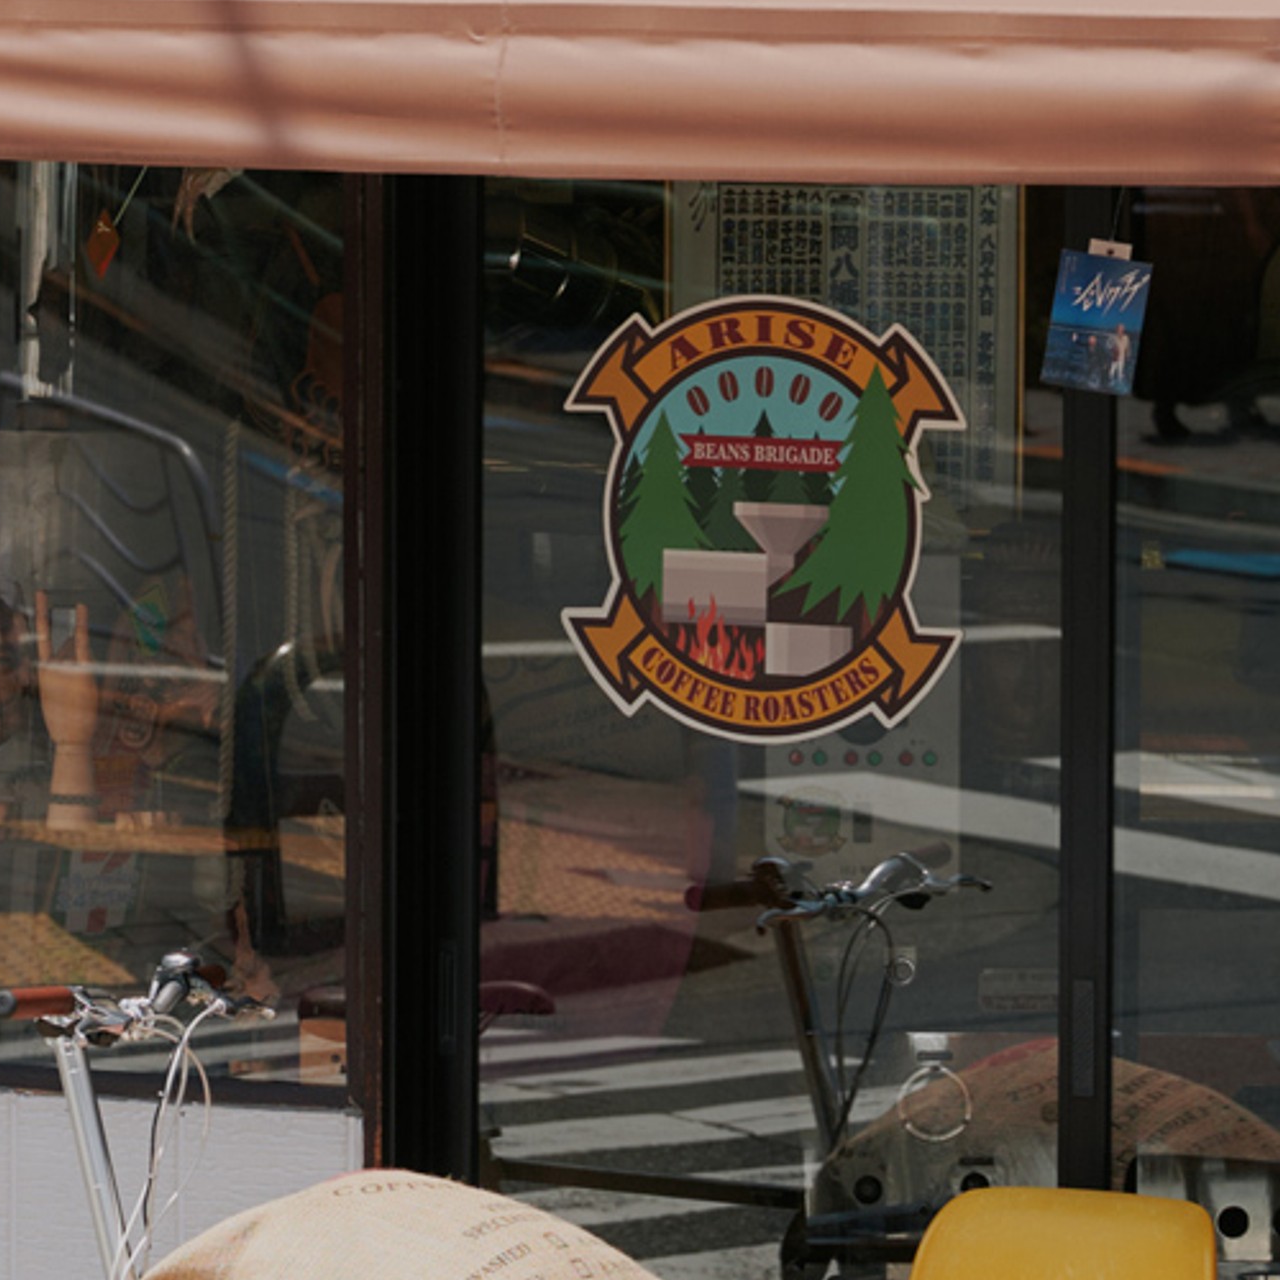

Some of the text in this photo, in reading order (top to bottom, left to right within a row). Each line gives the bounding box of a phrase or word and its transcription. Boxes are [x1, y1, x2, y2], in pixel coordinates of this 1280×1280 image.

[668, 315, 858, 372] ARISE
[694, 441, 835, 465] BEANS BRIGADE
[642, 646, 880, 723] COFFEE ROASTERS
